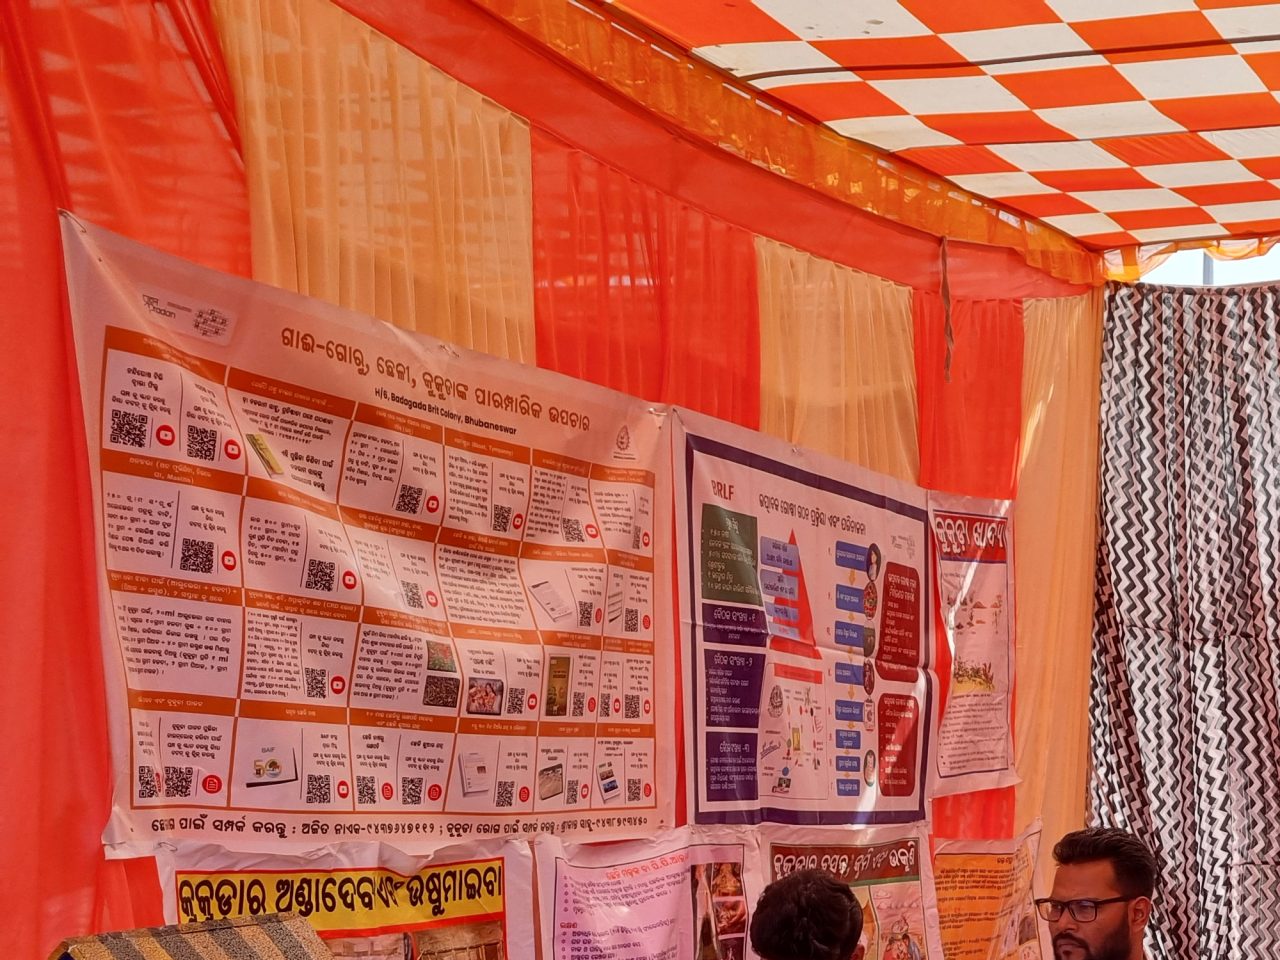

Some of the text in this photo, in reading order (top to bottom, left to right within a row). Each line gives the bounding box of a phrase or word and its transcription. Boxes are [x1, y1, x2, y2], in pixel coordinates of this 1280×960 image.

[374, 387, 391, 401] H/6,
[427, 403, 439, 416] Brit
[439, 406, 463, 424] Colony,
[465, 415, 517, 436] Bhubaneswar
